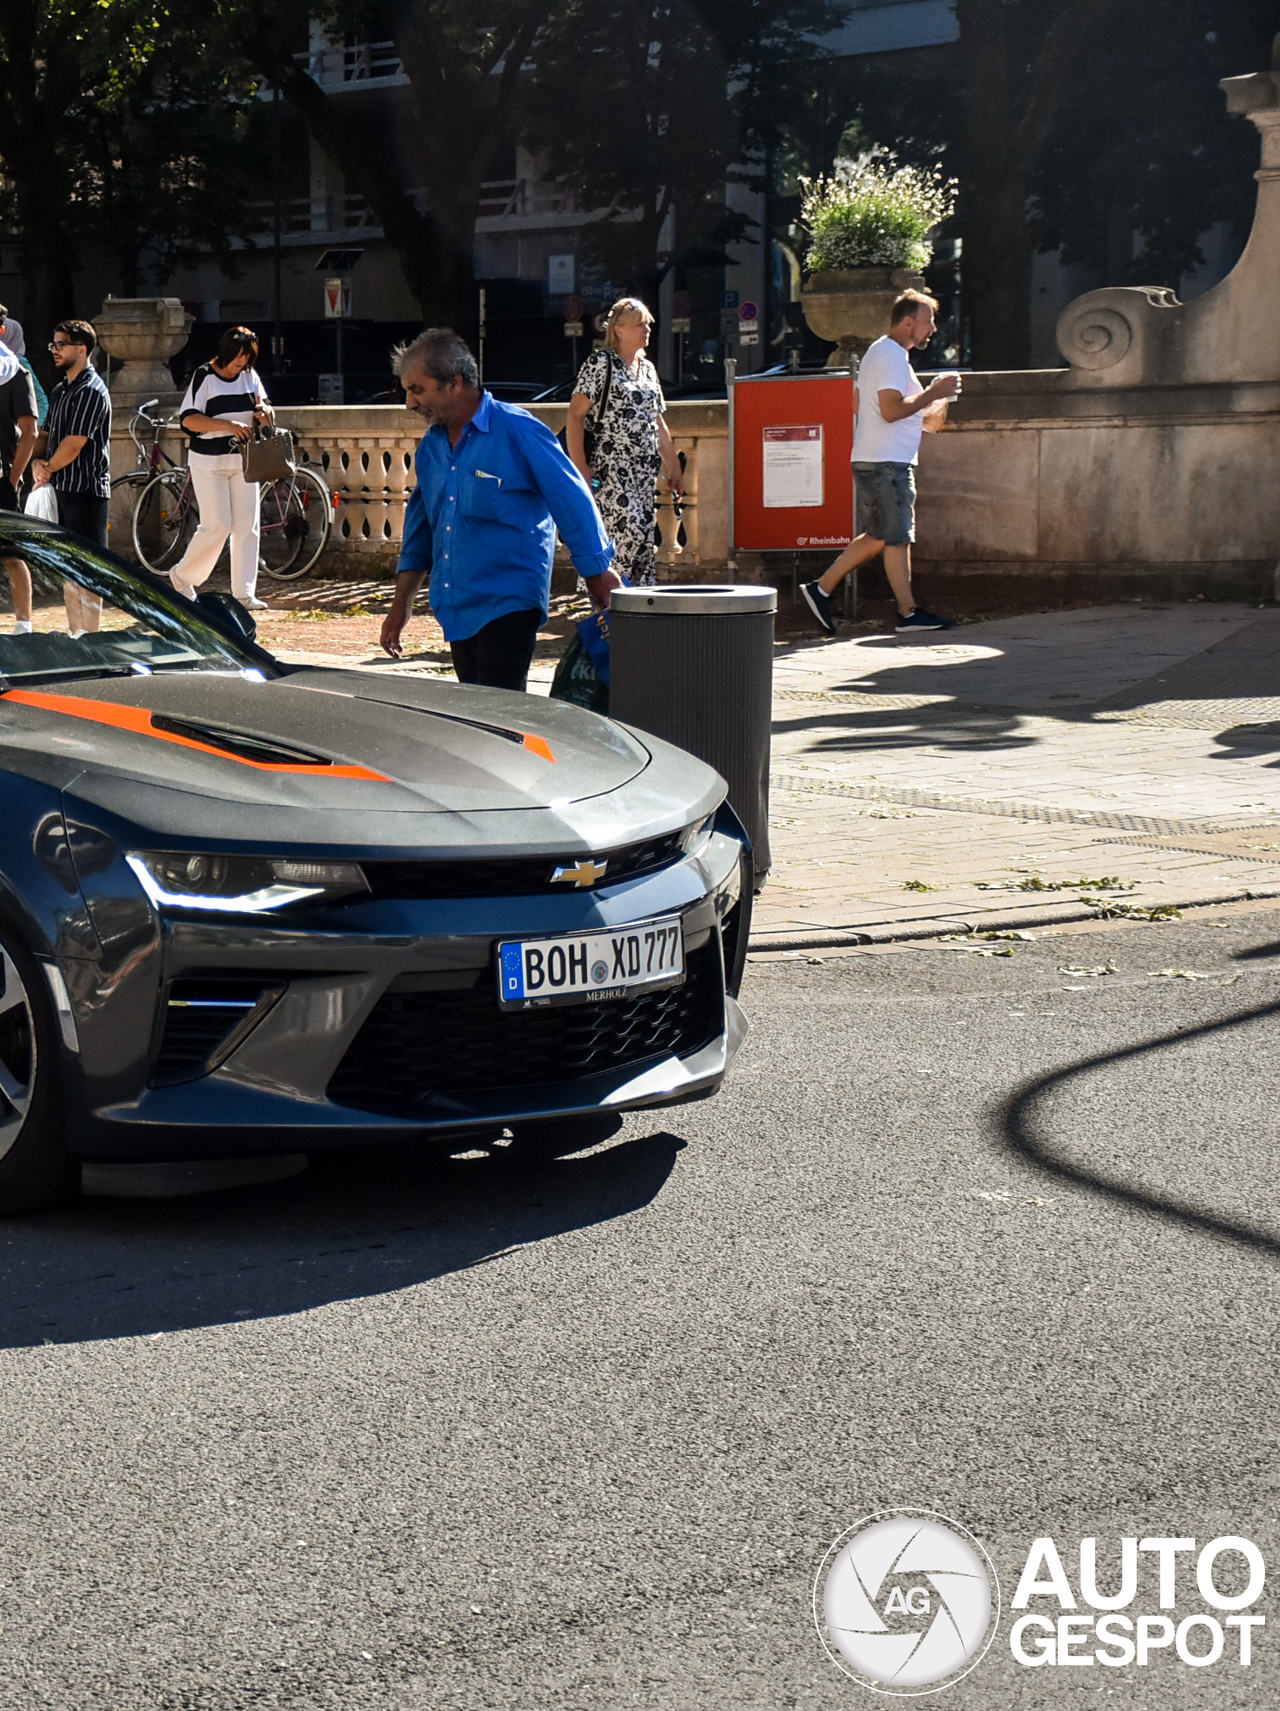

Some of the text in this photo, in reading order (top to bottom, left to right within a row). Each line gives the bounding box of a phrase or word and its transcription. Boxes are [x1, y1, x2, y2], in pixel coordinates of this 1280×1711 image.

[809, 536, 851, 544] Rheinbahn
[525, 942, 588, 991] BOH
[508, 976, 518, 990] D
[586, 987, 628, 1002] MERHOLZ
